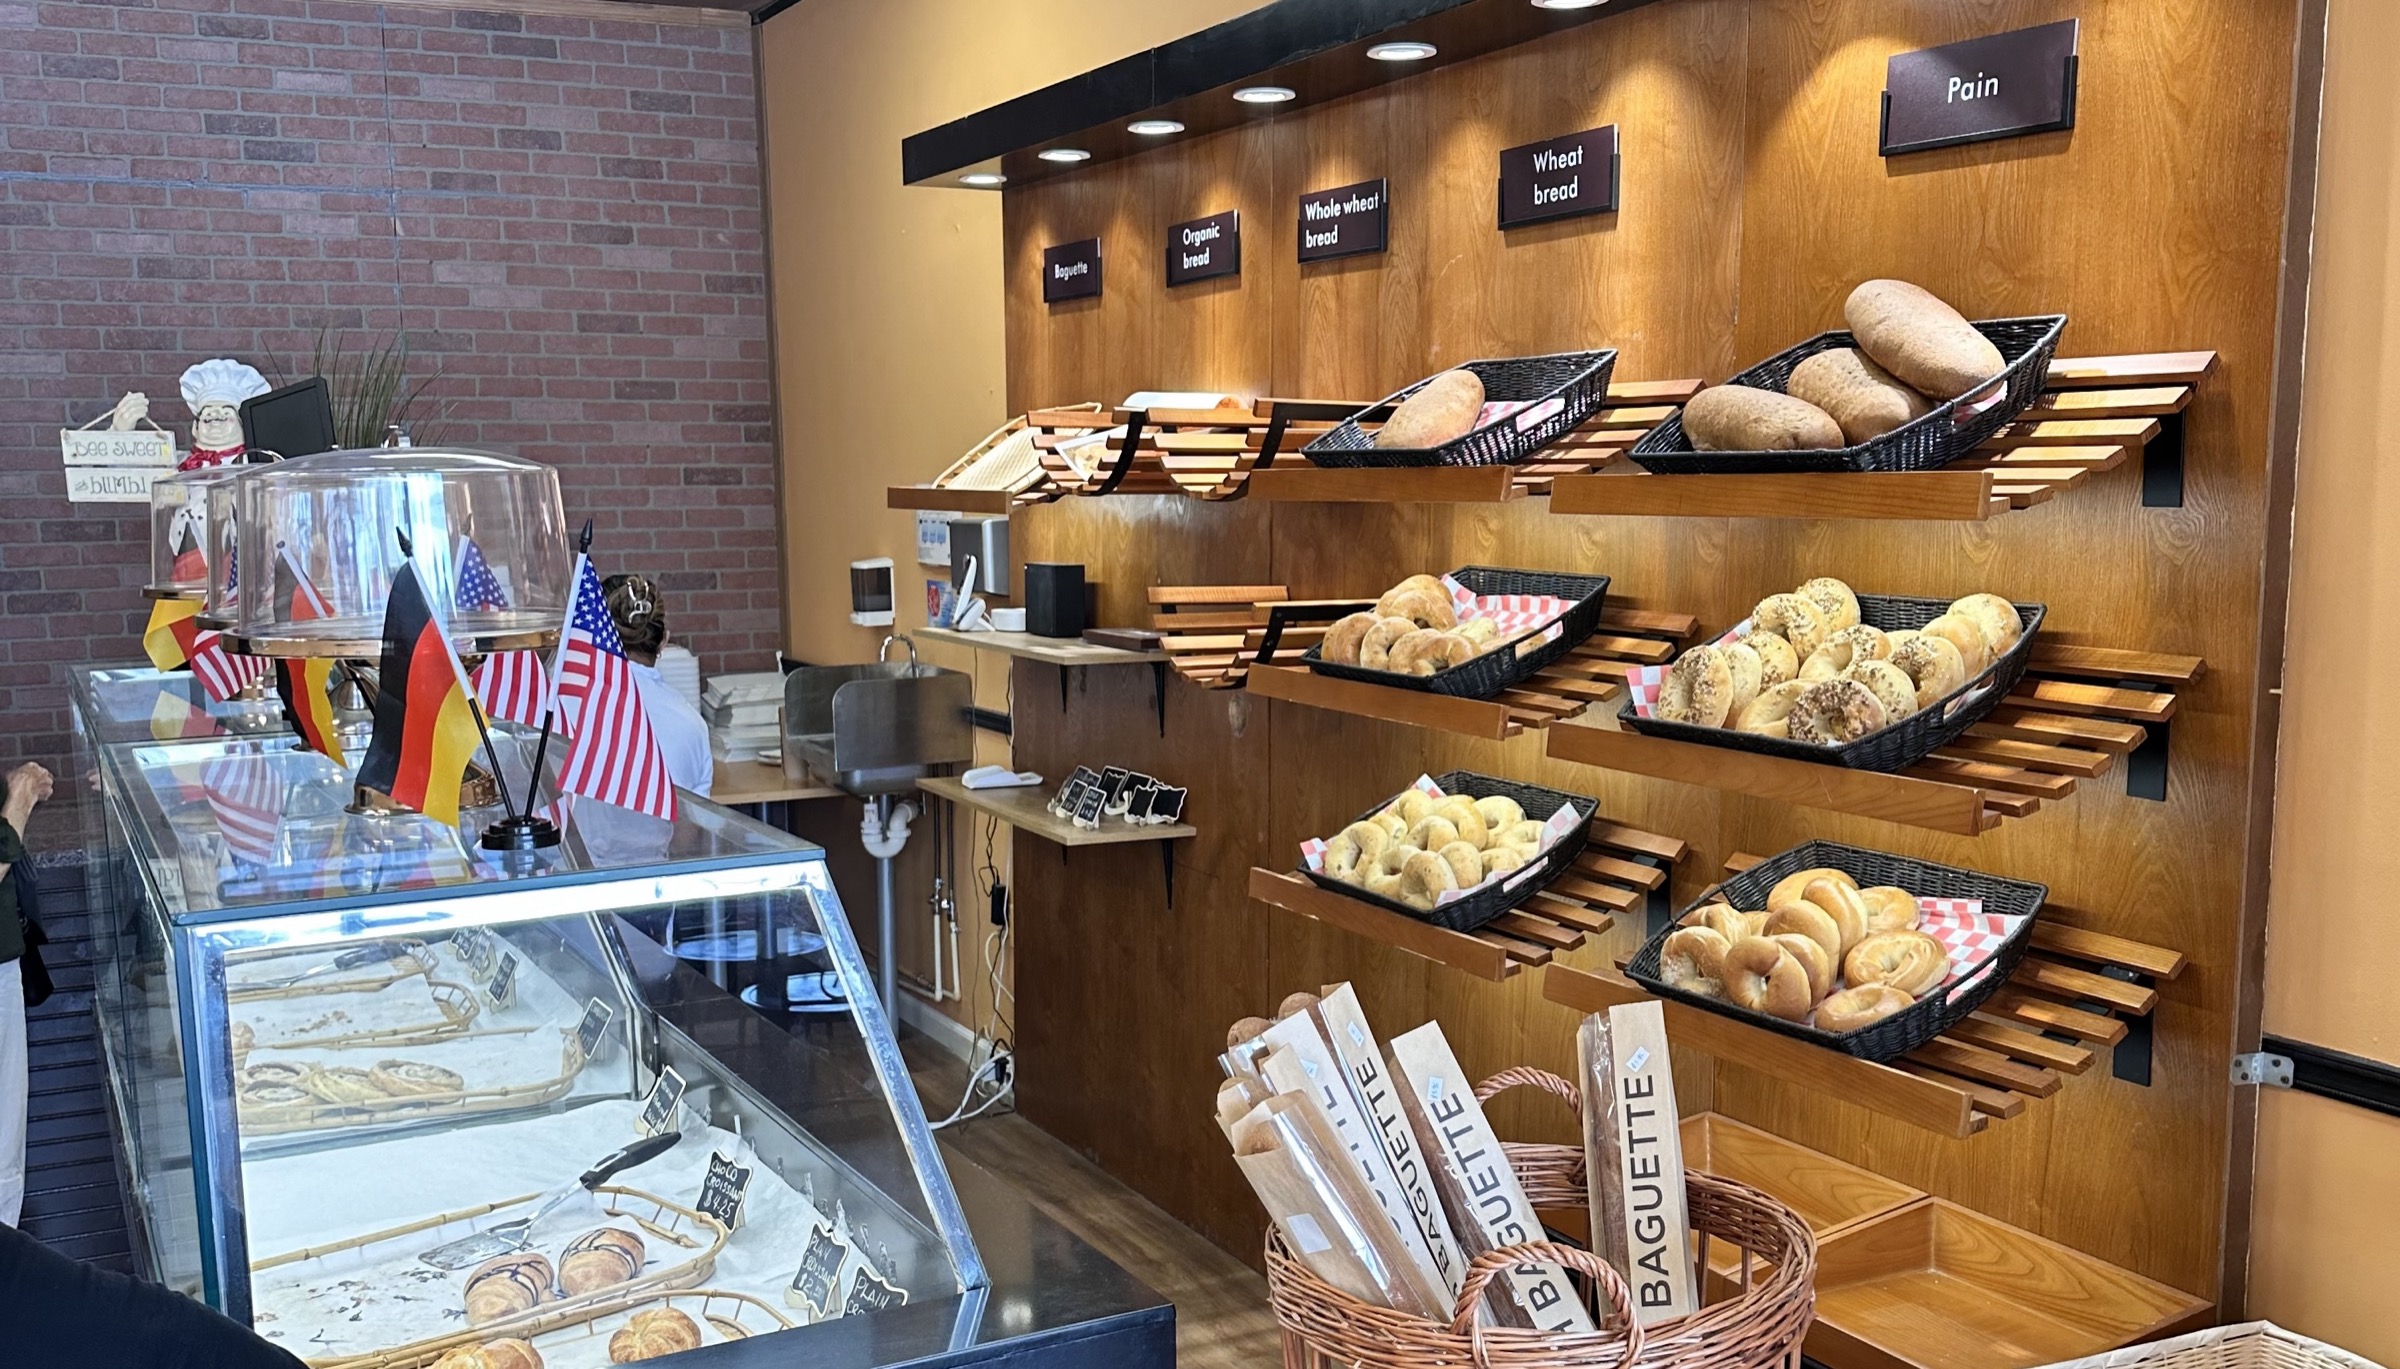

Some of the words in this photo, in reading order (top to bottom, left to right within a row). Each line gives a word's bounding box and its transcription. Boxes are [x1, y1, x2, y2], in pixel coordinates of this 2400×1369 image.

[1947, 72, 1999, 103] Pain
[1533, 145, 1584, 173] Wheat
[1533, 175, 1578, 205] bread
[1305, 198, 1341, 221] Whole
[1342, 192, 1379, 215] wheat
[1183, 222, 1220, 247] Organic
[1305, 225, 1338, 248] bread
[1054, 261, 1088, 281] Baguette
[1183, 247, 1210, 269] bread
[1355, 1056, 1451, 1274] BAGUETTE
[1624, 1075, 1672, 1307] BAGUETTE
[853, 1276, 891, 1309] PLAIN
